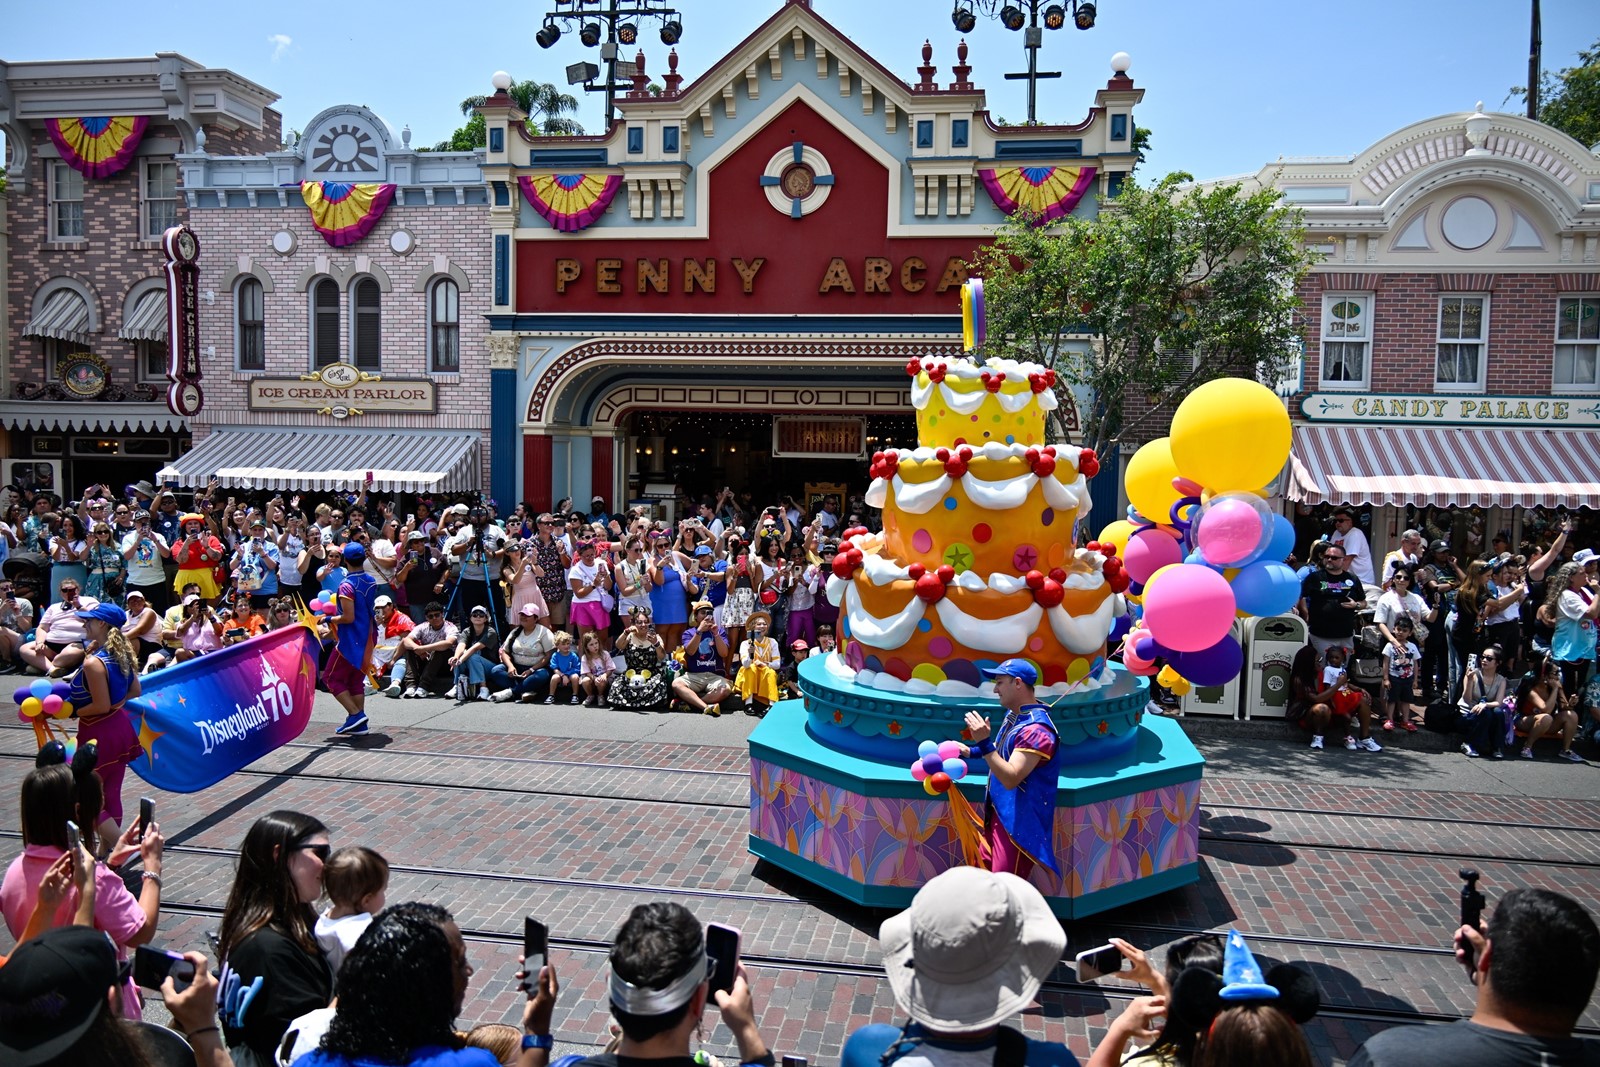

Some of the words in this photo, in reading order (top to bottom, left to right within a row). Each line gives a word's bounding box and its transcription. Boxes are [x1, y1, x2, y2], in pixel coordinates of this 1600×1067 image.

[186, 271, 194, 309] ICE
[554, 256, 767, 294] PENNY
[818, 256, 1030, 294] ARCA
[186, 312, 197, 374] CREAM
[1330, 321, 1360, 333] TYPING
[258, 387, 284, 398] ICE
[288, 388, 348, 399] CREAM
[353, 388, 427, 400] PARLOR
[1352, 398, 1449, 417] CANDY
[1460, 400, 1570, 420] PALACE
[192, 694, 269, 756] Disneyland
[261, 682, 294, 723] 70
